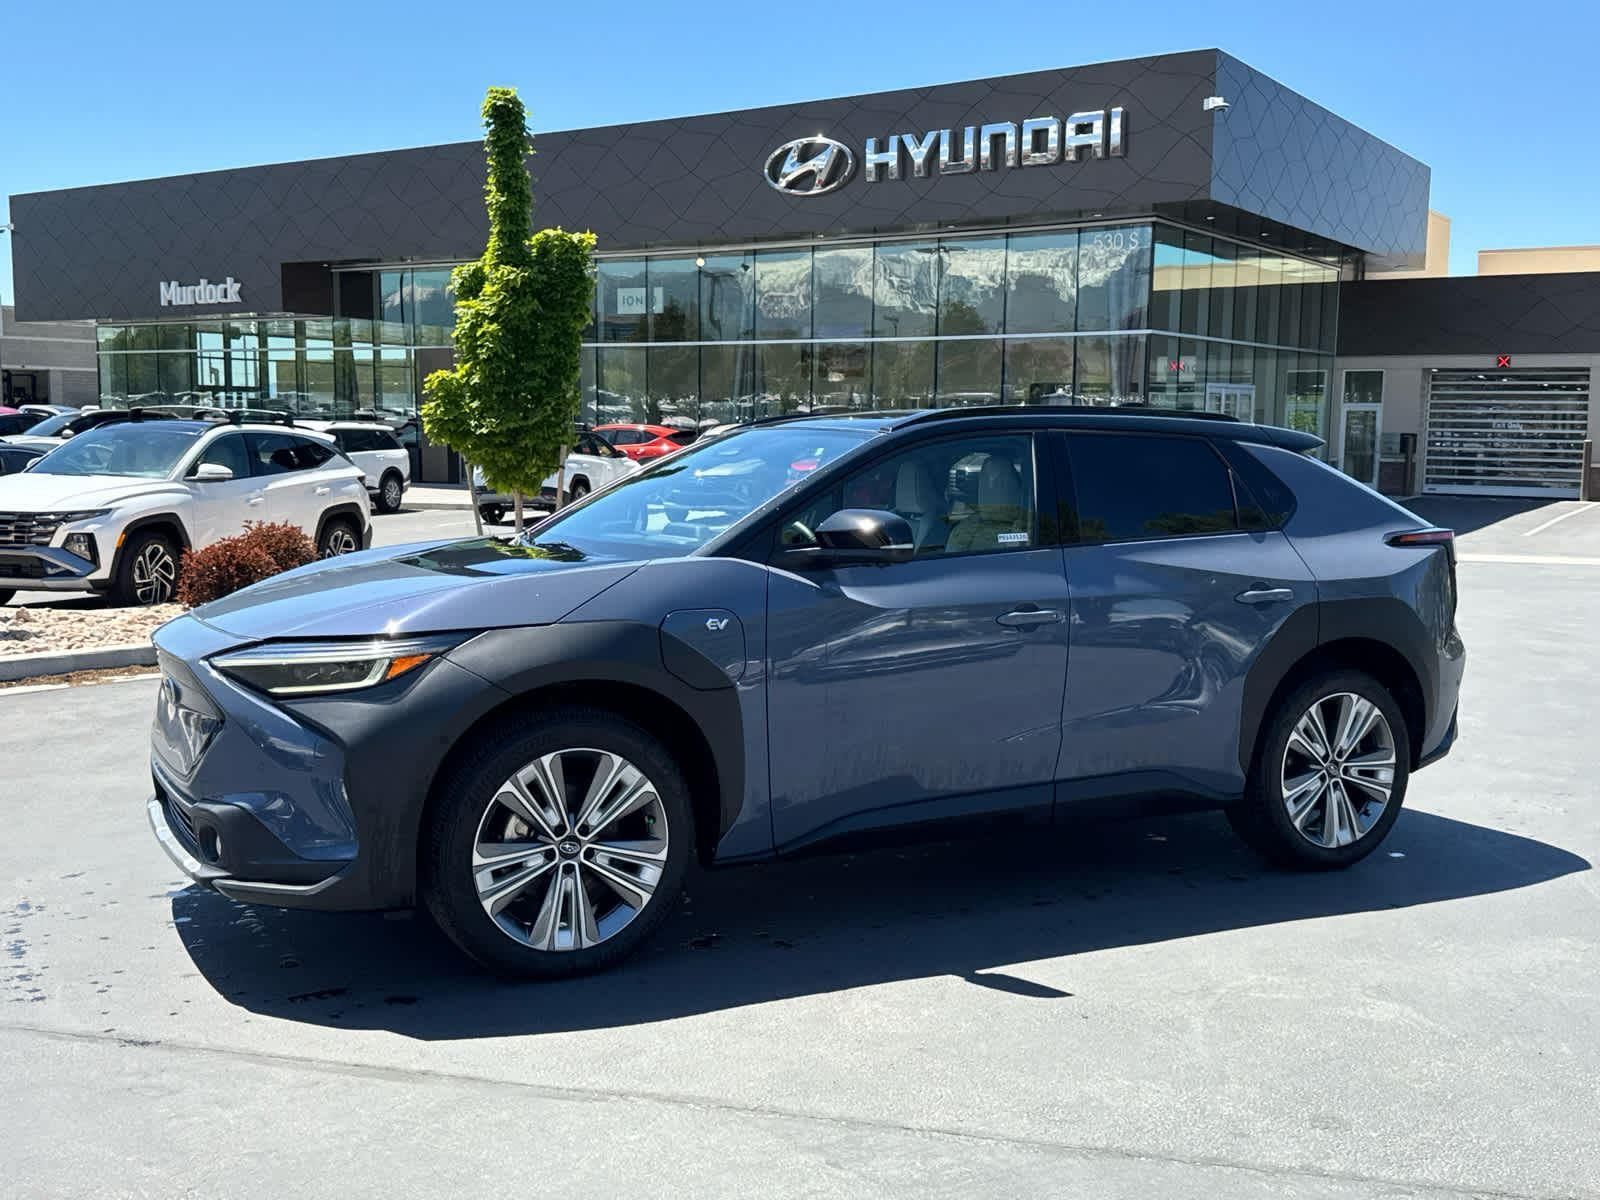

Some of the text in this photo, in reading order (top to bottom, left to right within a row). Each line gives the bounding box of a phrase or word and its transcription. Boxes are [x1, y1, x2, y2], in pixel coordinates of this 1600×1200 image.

[865, 106, 1126, 183] HYUNDAI
[1094, 231, 1139, 250] 530 S
[159, 277, 242, 306] Murdock
[705, 617, 729, 631] EV
